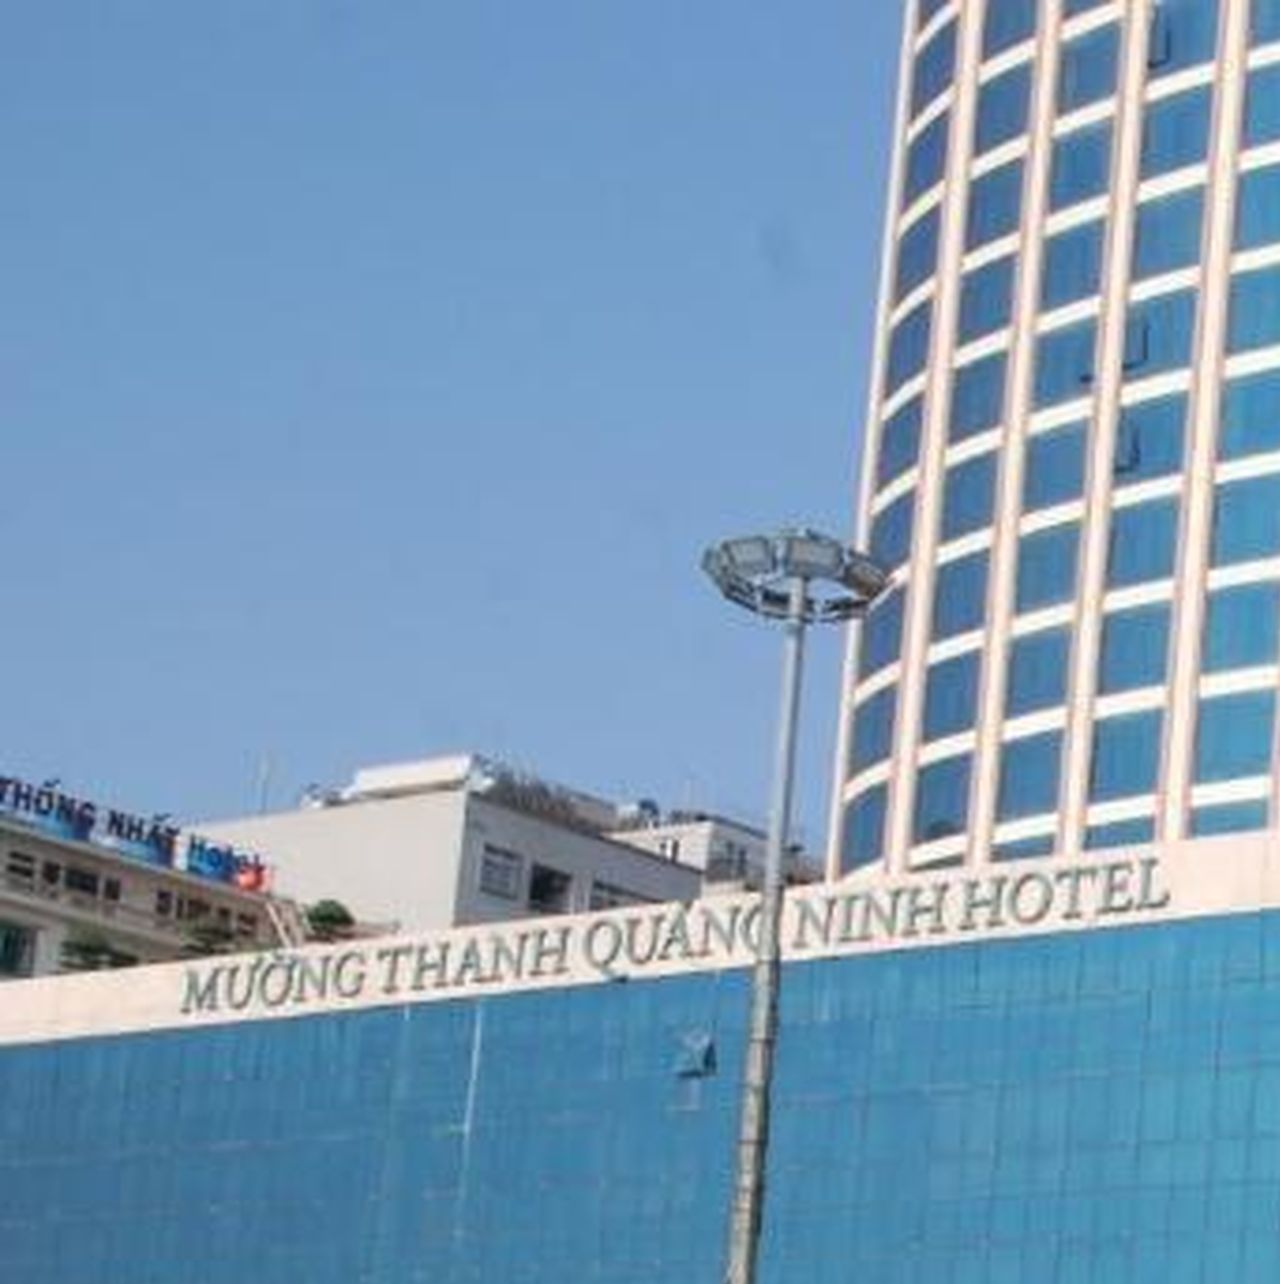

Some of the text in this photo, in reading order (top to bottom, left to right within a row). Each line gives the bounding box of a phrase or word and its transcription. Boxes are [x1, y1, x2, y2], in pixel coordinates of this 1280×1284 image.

[377, 930, 570, 993] THANH
[793, 883, 949, 948] NINH
[958, 857, 1170, 930] HOTEL
